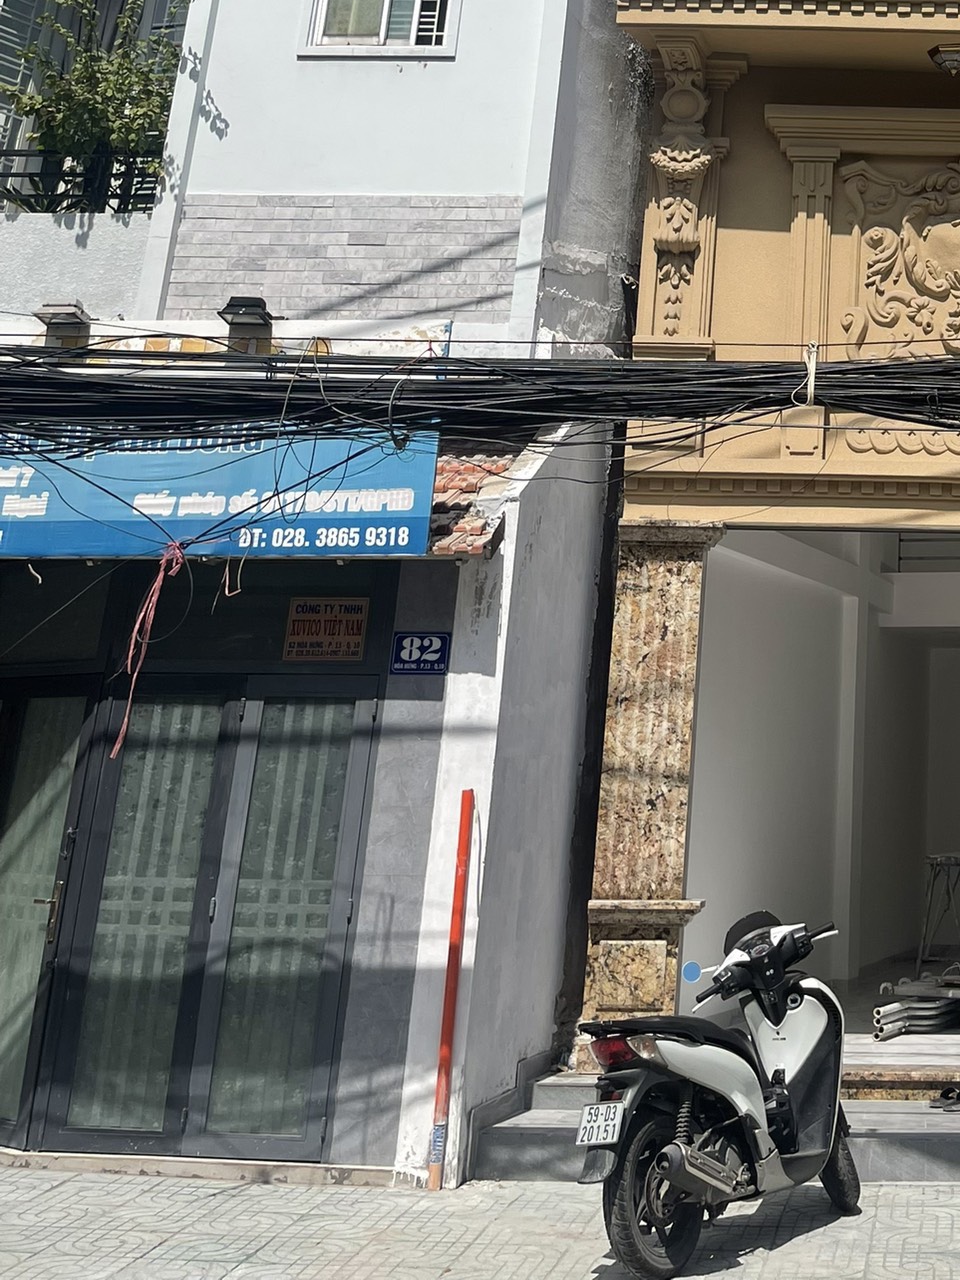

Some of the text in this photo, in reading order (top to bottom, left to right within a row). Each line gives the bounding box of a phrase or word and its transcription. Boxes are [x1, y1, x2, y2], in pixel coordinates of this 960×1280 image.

[238, 526, 409, 548] ĐT: 028. 3865 9318
[296, 602, 363, 614] CÔNG TY TNHH
[290, 619, 321, 636] XUVICO
[344, 619, 363, 636] NAM
[400, 636, 442, 662] 82
[587, 1105, 617, 1123] 59-D3
[580, 1123, 616, 1142] 201.51
